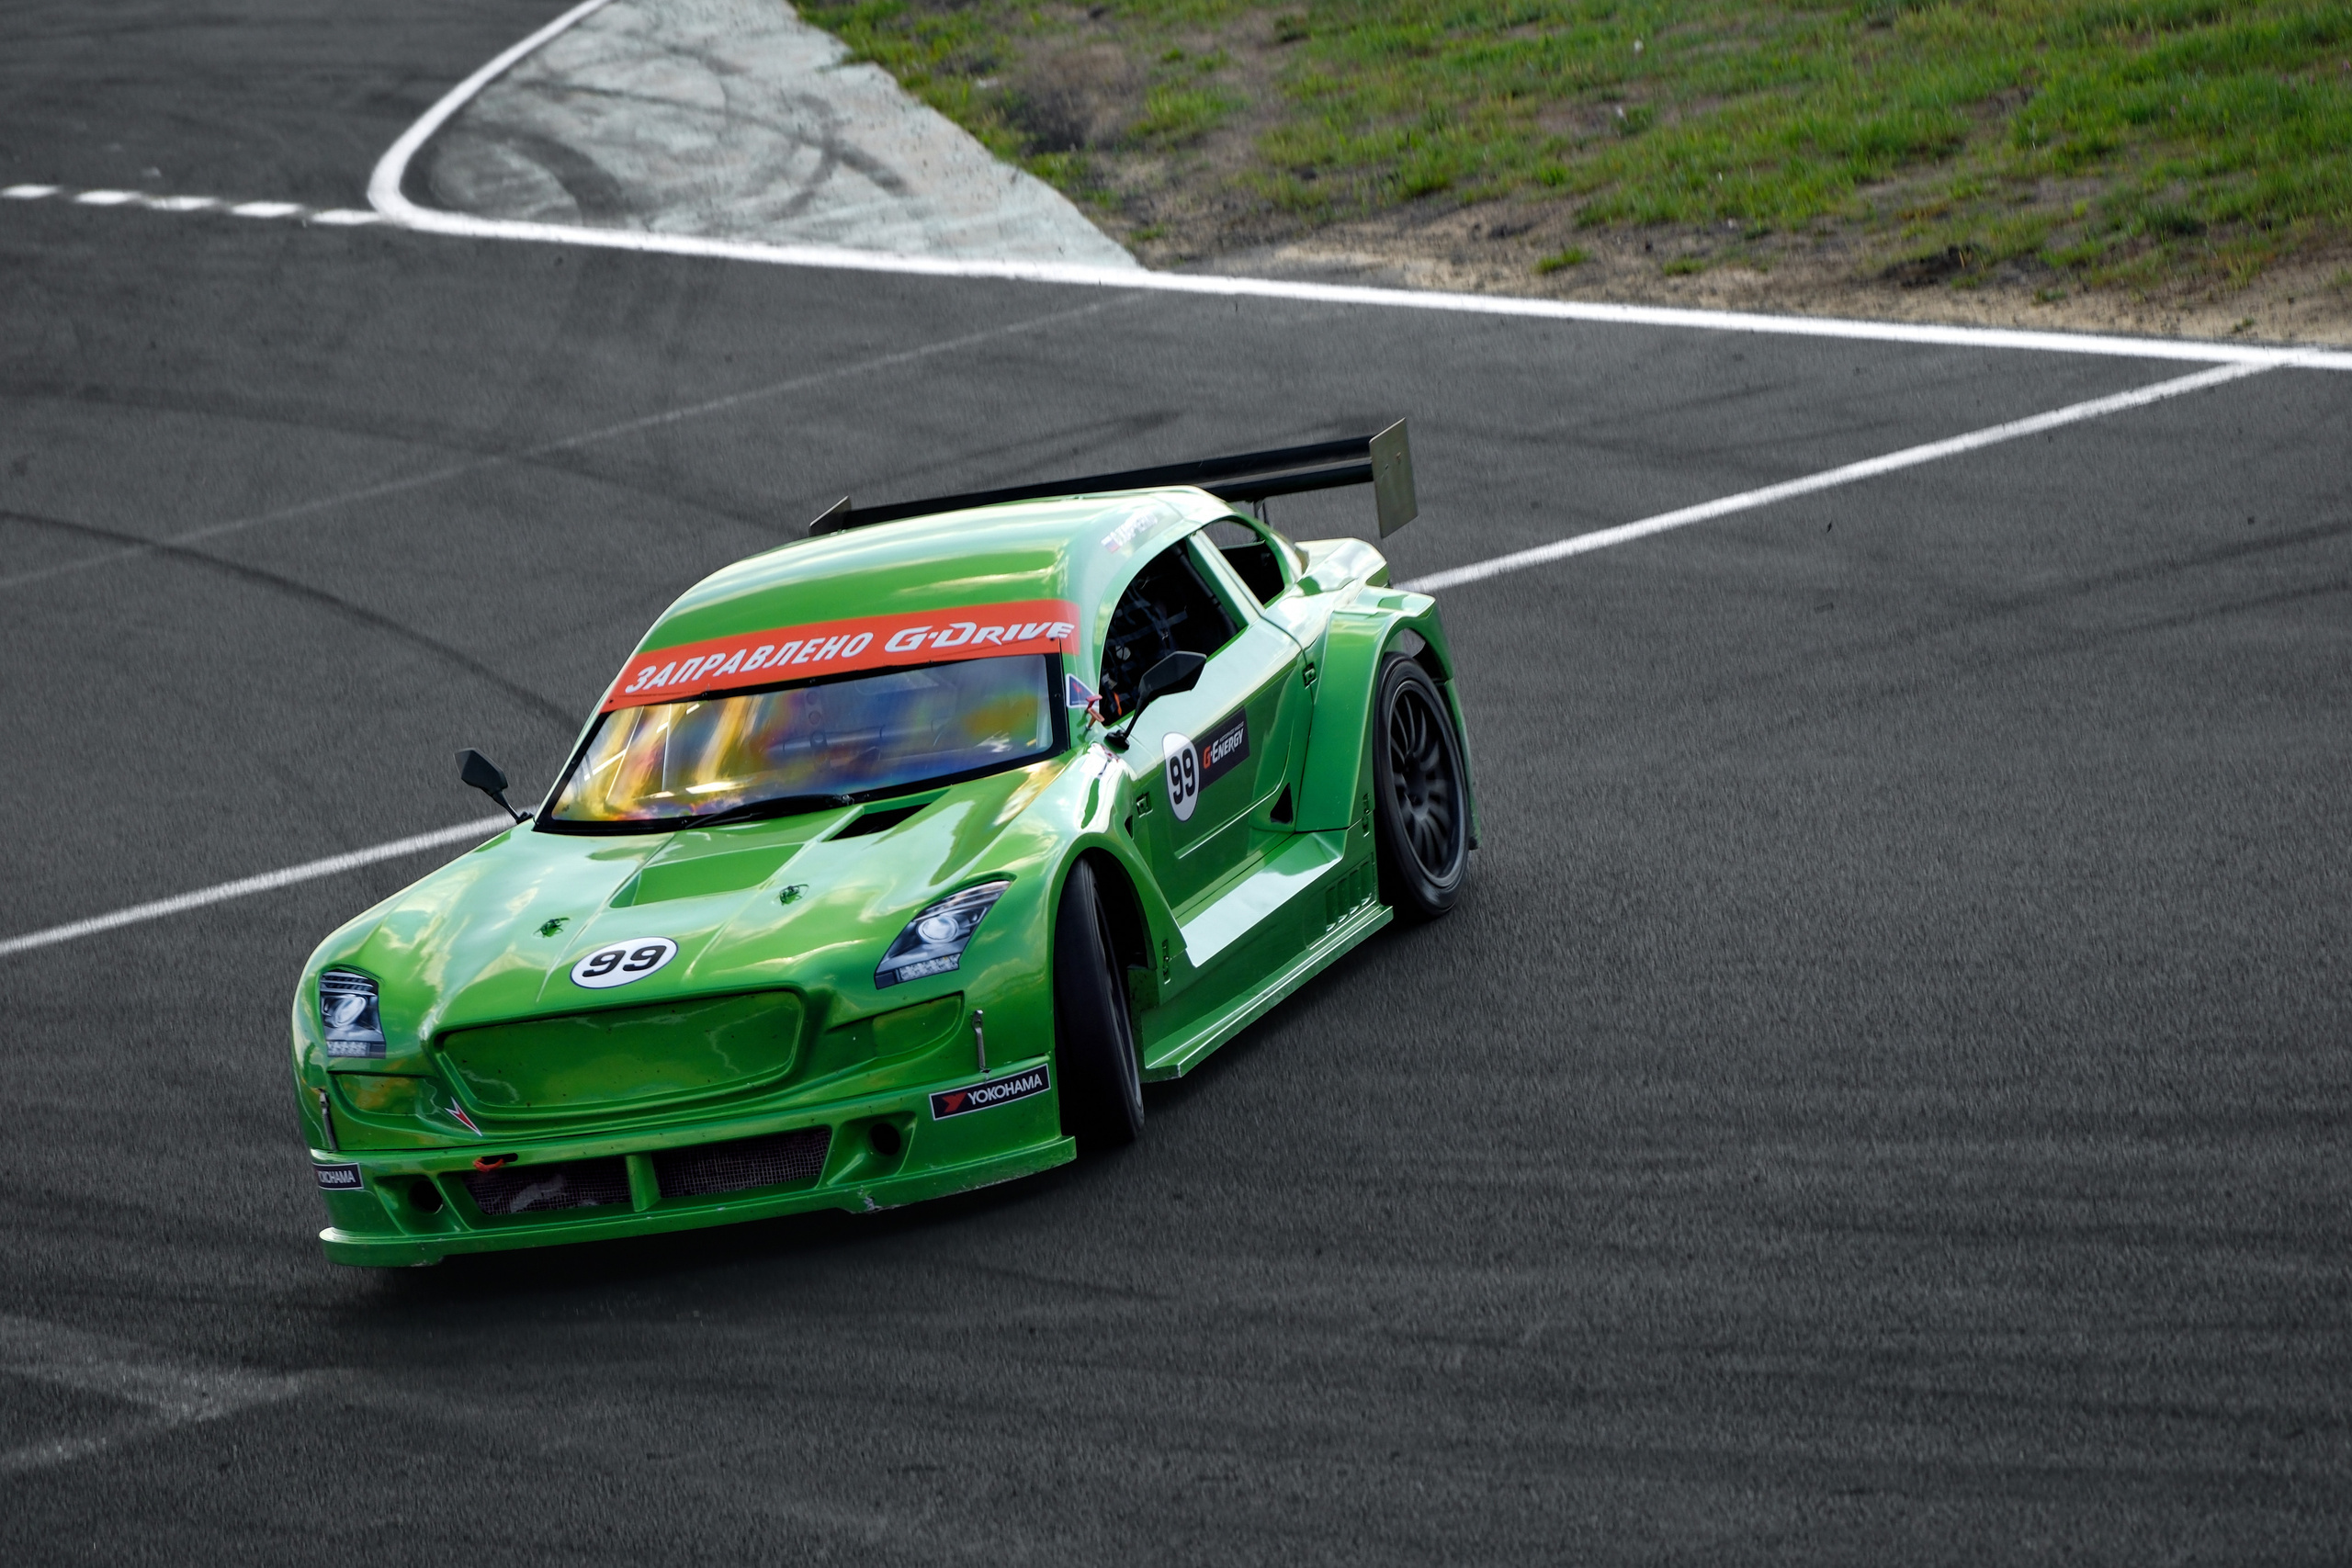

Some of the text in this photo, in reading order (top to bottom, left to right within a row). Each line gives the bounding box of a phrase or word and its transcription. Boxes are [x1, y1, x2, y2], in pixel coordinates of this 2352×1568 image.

[625, 632, 874, 694] ЗАПРАВЛЕНО
[1170, 748, 1195, 806] 99
[582, 944, 667, 977] 99
[967, 1074, 1043, 1105] YOKOHAMA
